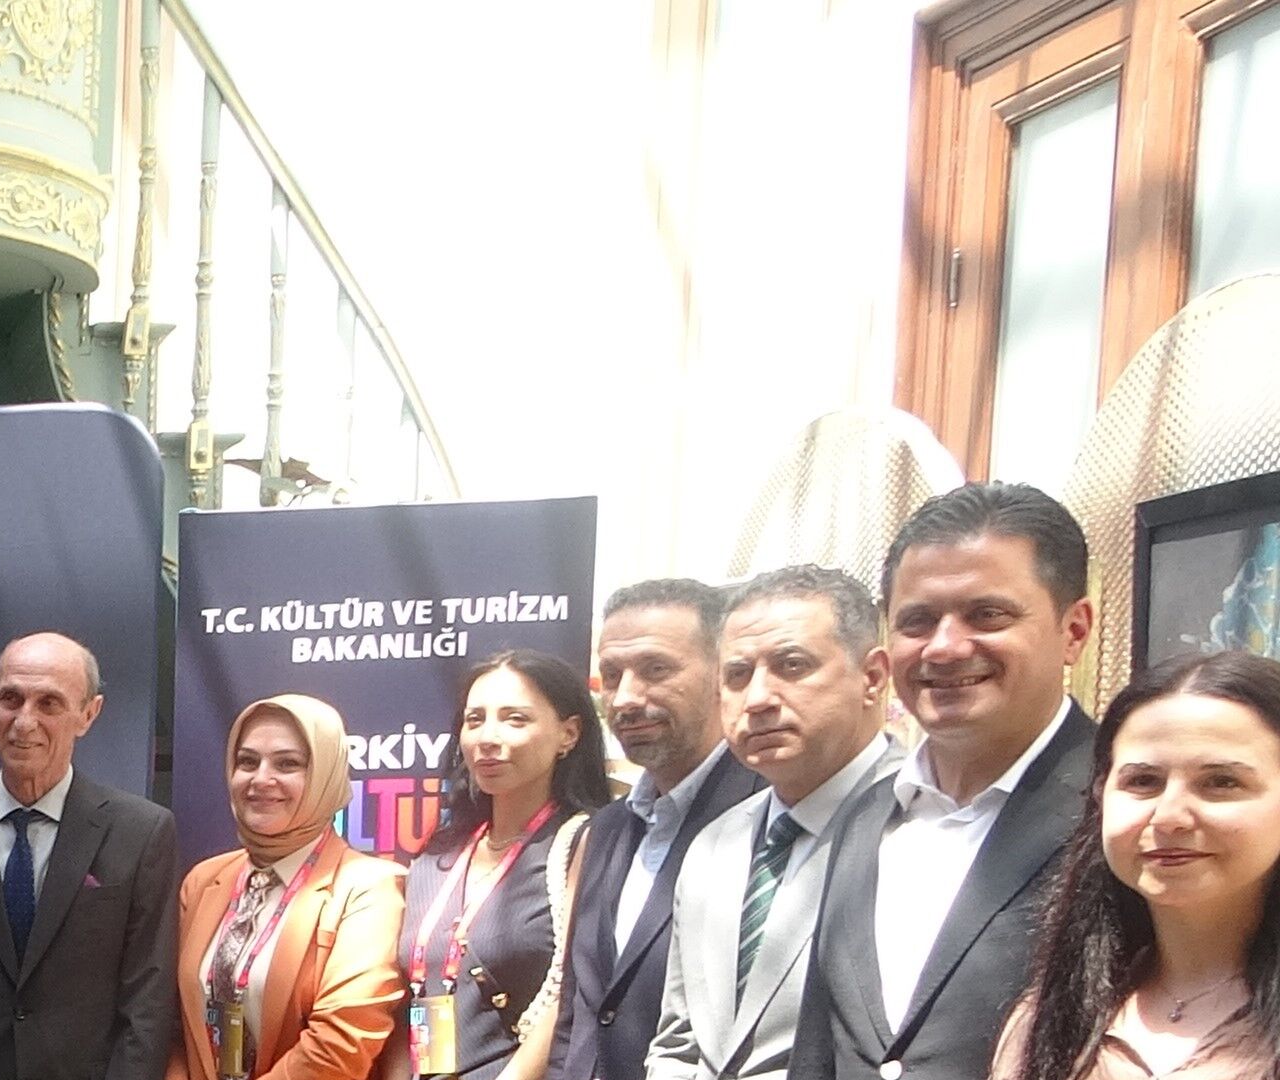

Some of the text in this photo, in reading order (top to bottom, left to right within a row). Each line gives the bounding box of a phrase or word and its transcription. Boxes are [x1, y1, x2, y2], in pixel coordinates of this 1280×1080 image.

[201, 590, 569, 633] T.C. KÜLTÜR VE TURİZM
[291, 629, 468, 662] BAKANLIĞI
[346, 723, 452, 770] RKİY
